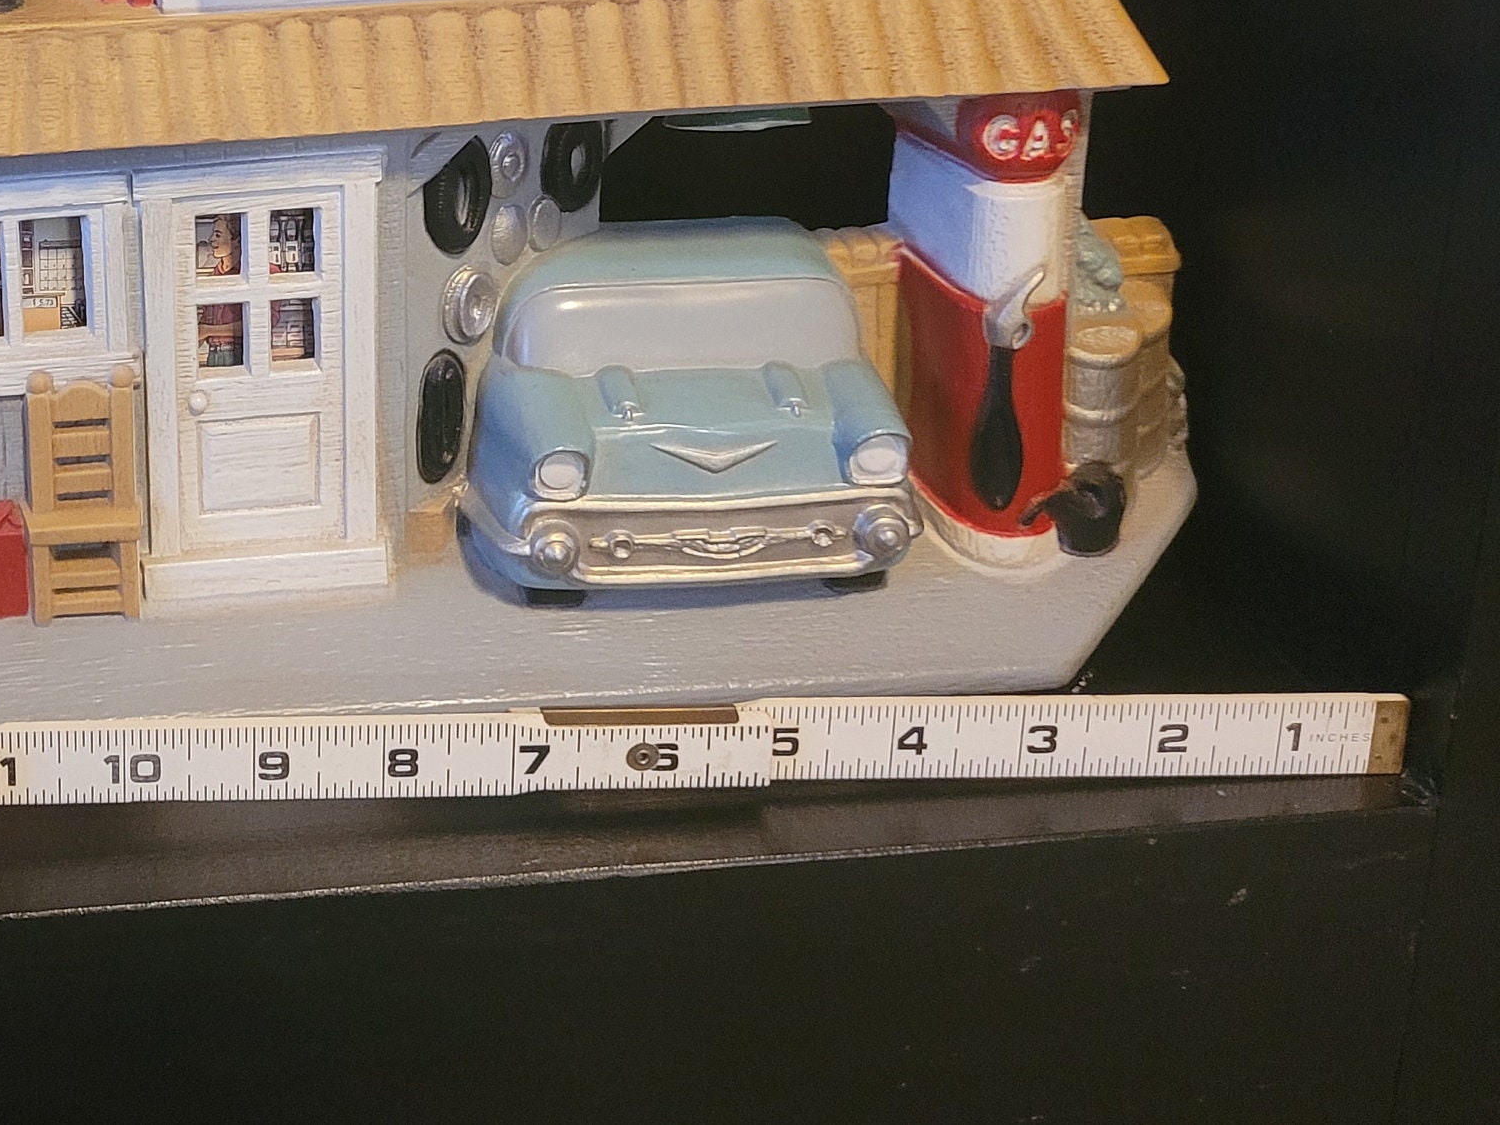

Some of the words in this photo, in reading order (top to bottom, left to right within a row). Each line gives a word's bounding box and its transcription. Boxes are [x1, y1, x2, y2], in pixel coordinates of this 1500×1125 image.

[982, 108, 1079, 162] GAS
[103, 754, 162, 784] 10
[258, 751, 290, 781] 9
[387, 748, 419, 778] 8
[519, 744, 551, 775] 7
[771, 727, 799, 757] 5
[897, 726, 928, 756] 4
[1026, 725, 1058, 754] 3
[1157, 724, 1189, 753] 2
[1286, 722, 1302, 752] 1
[1308, 732, 1371, 743] INCHES
